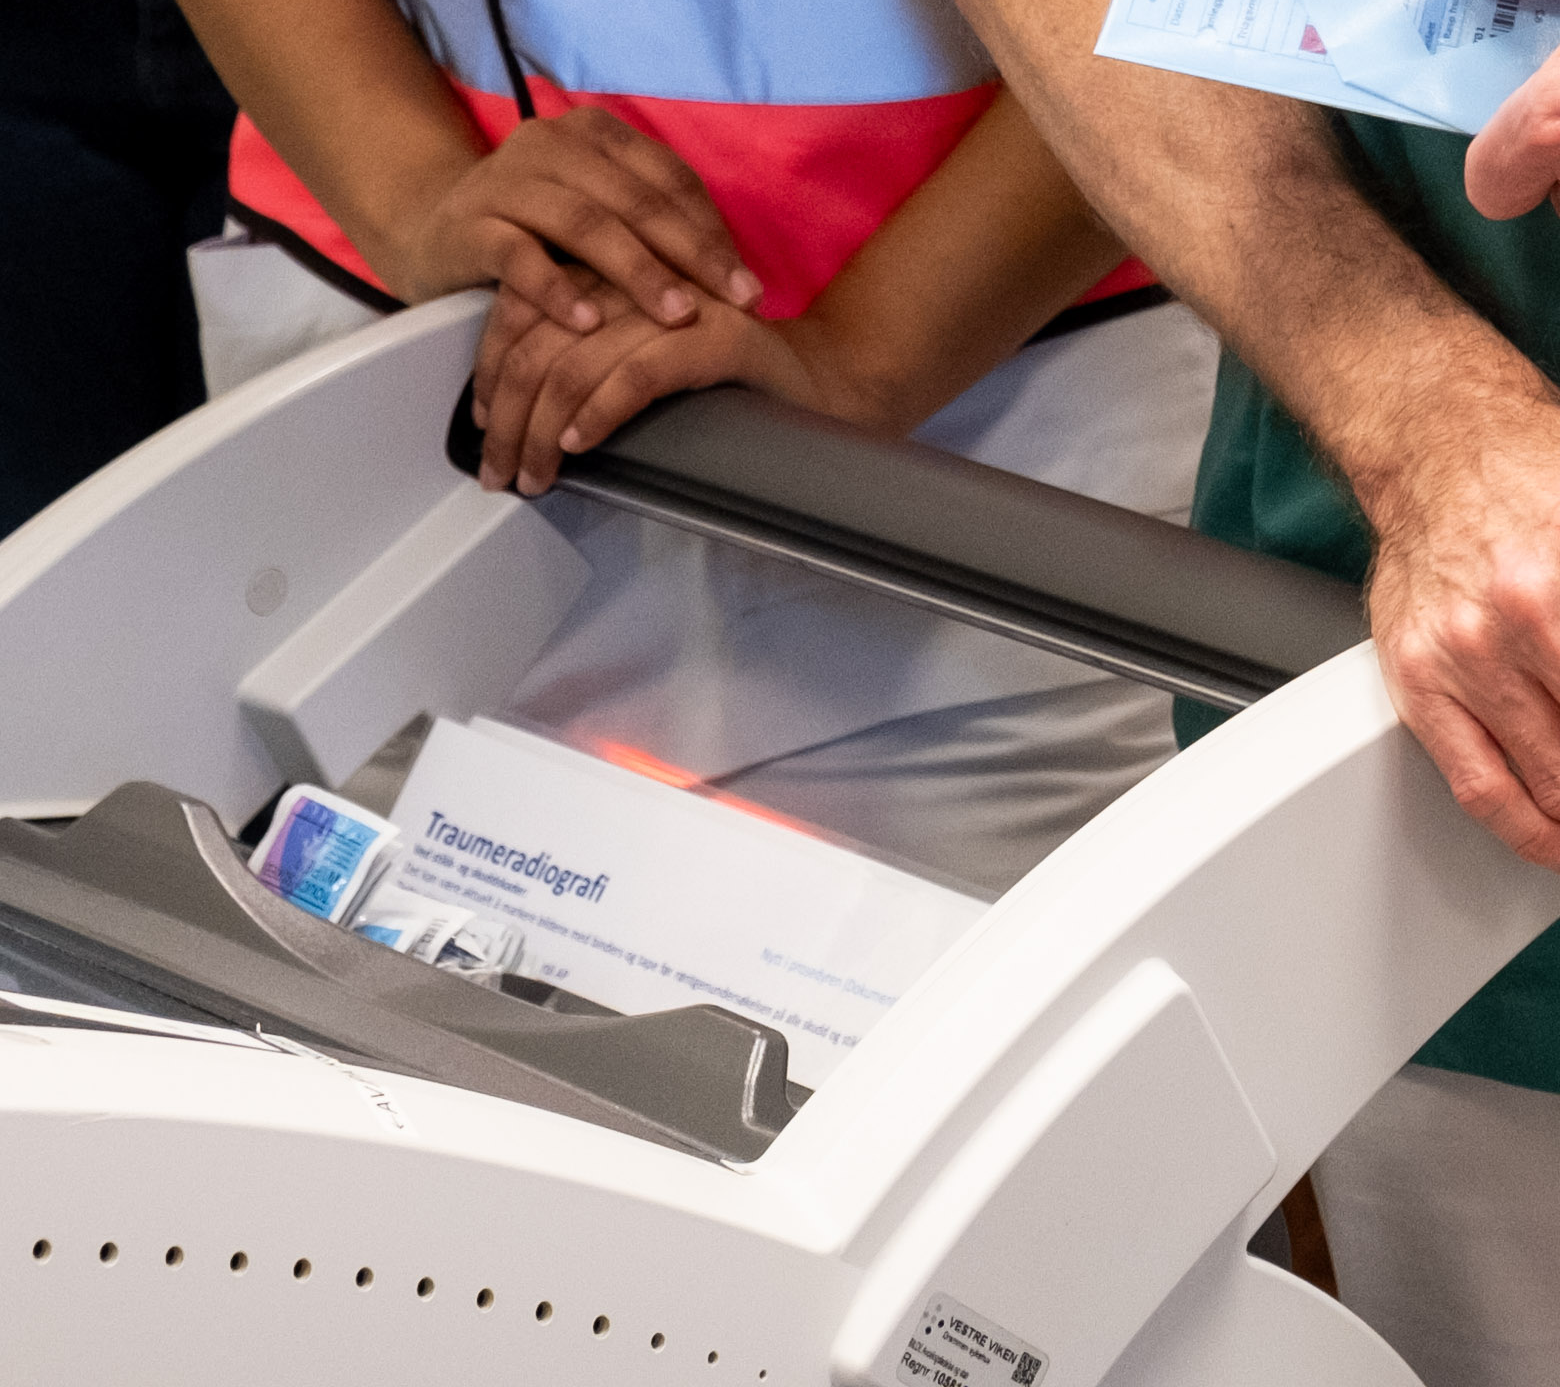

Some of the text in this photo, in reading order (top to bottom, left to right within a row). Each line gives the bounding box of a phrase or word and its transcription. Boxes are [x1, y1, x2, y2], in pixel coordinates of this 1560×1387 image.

[425, 811, 607, 903] Traumeradiografi
[949, 1317, 1019, 1364] VESTRE VIKEN
